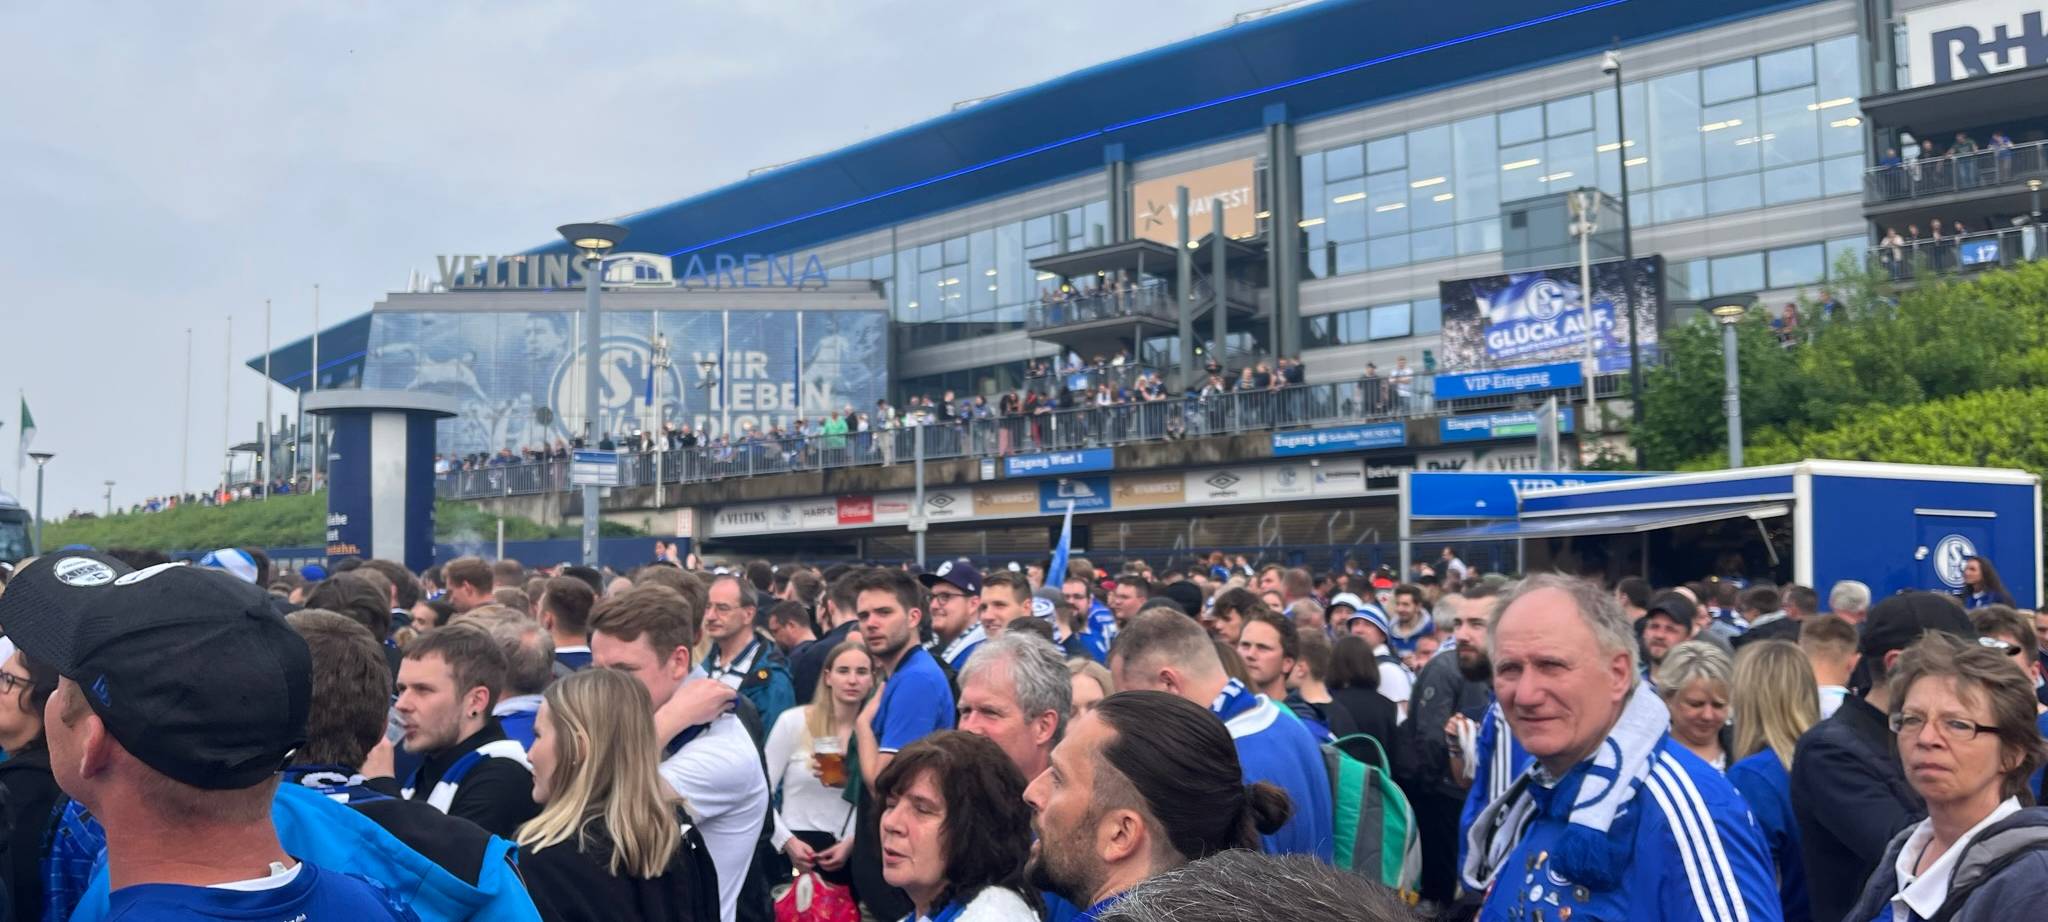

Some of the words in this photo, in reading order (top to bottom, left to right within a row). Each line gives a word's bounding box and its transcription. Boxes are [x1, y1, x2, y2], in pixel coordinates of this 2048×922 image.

[1976, 245, 1998, 262] 17
[436, 255, 590, 288] VELTINS
[681, 253, 830, 288] ARENA
[1488, 320, 1560, 350] GLÜCK
[692, 352, 769, 380] WIR
[1464, 371, 1550, 392] VIP-Eingang
[709, 382, 832, 412] LEBEN
[1274, 433, 1317, 449] Zugang
[1009, 457, 1049, 470] Eingang
[1050, 453, 1075, 465] West
[1077, 453, 1084, 463] 1
[1498, 455, 1569, 471] VELTS
[727, 511, 766, 523] VELTINS
